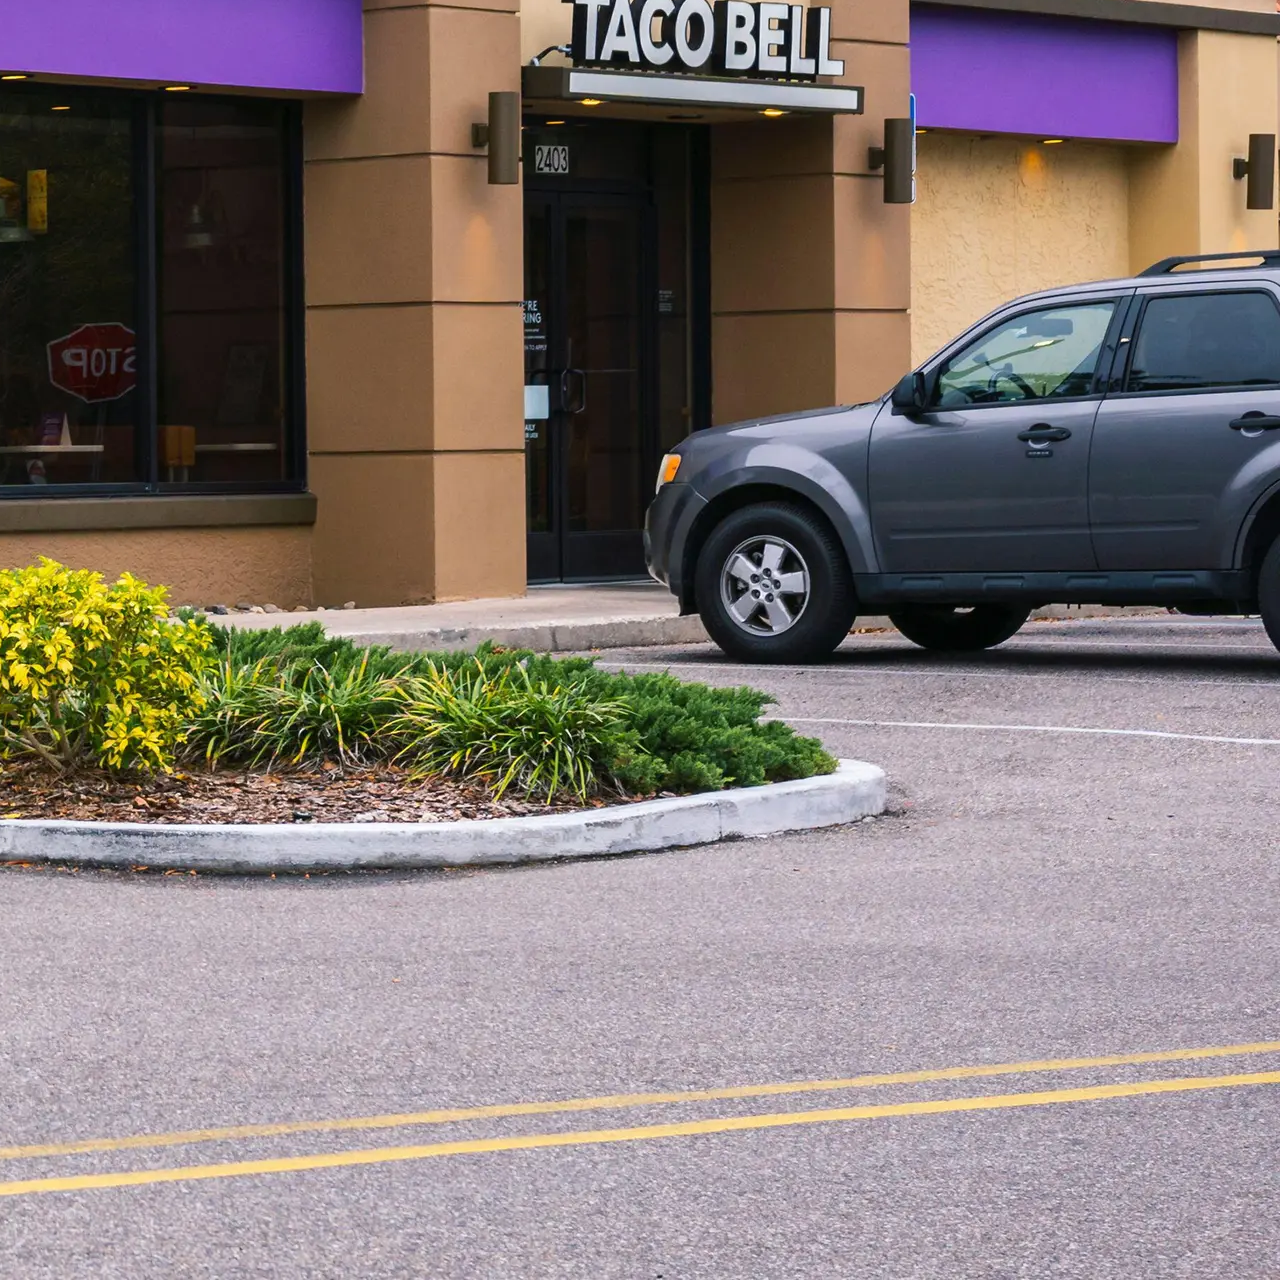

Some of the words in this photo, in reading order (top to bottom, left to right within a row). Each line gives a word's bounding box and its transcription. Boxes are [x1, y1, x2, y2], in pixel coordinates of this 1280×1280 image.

[719, 0, 845, 77] BELL
[536, 146, 569, 173] 2403
[521, 301, 538, 311] E'RE
[523, 312, 542, 323] RING
